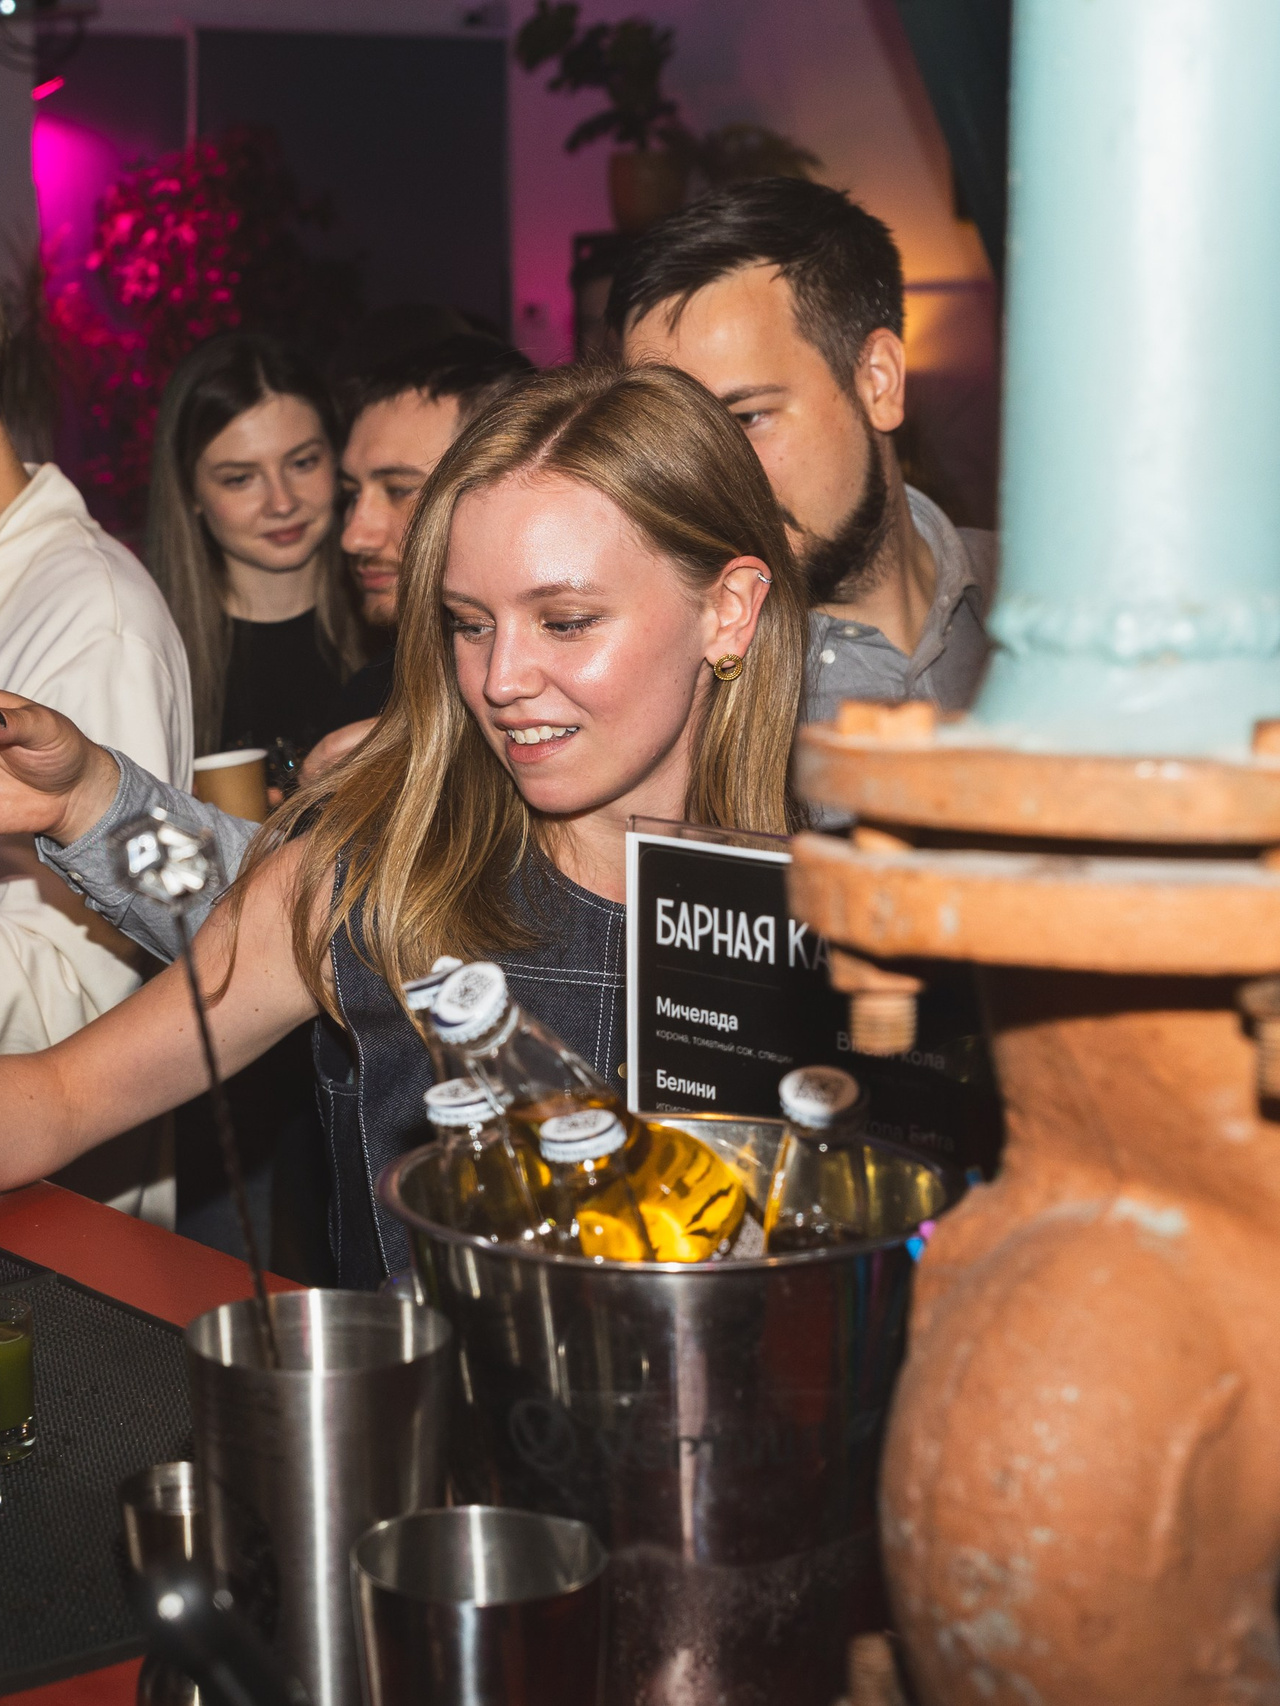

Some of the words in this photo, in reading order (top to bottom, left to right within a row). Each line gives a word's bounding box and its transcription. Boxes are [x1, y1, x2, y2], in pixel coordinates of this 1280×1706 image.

[656, 897, 776, 966] БАРНАЯ
[788, 918, 831, 971] КА
[656, 995, 739, 1032] Мичелада
[656, 1068, 717, 1101] Белини
